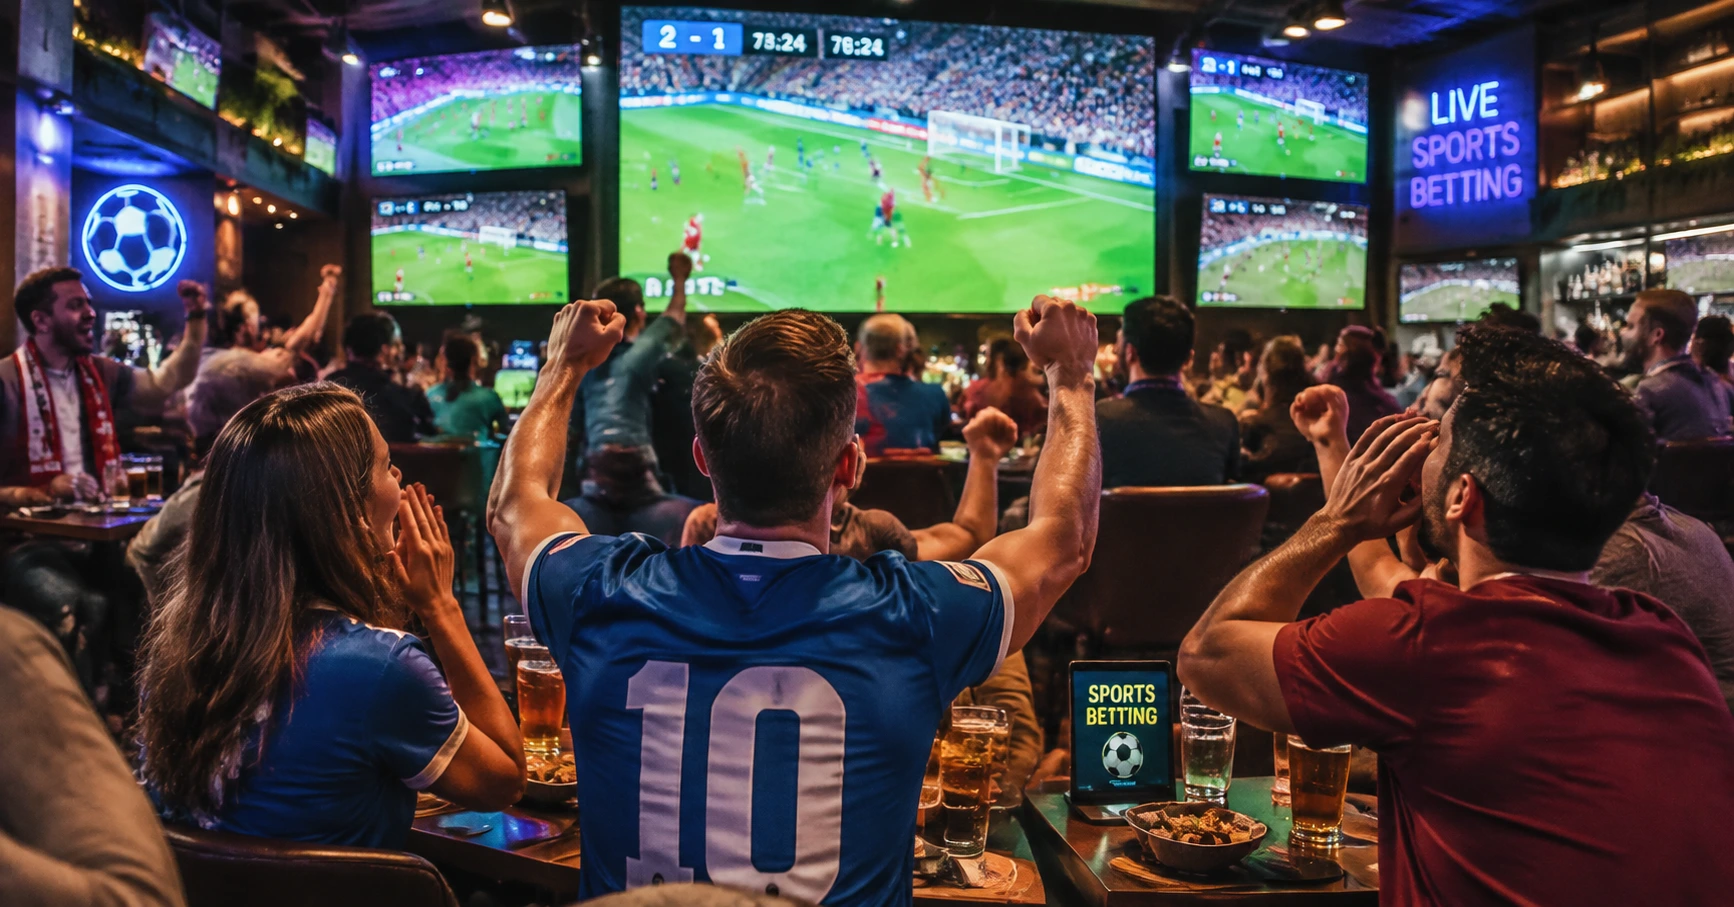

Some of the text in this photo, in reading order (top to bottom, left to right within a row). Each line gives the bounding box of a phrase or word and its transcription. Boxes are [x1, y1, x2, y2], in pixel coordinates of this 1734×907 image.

[659, 24, 677, 49] 2
[711, 27, 726, 50] 1
[1431, 80, 1500, 126] LIVE
[1412, 120, 1521, 169] SPORTS
[1410, 163, 1523, 209] BETTING
[1086, 706, 1158, 726] BETTING
[1088, 684, 1156, 704] SPORTS
[626, 660, 847, 902] 10
